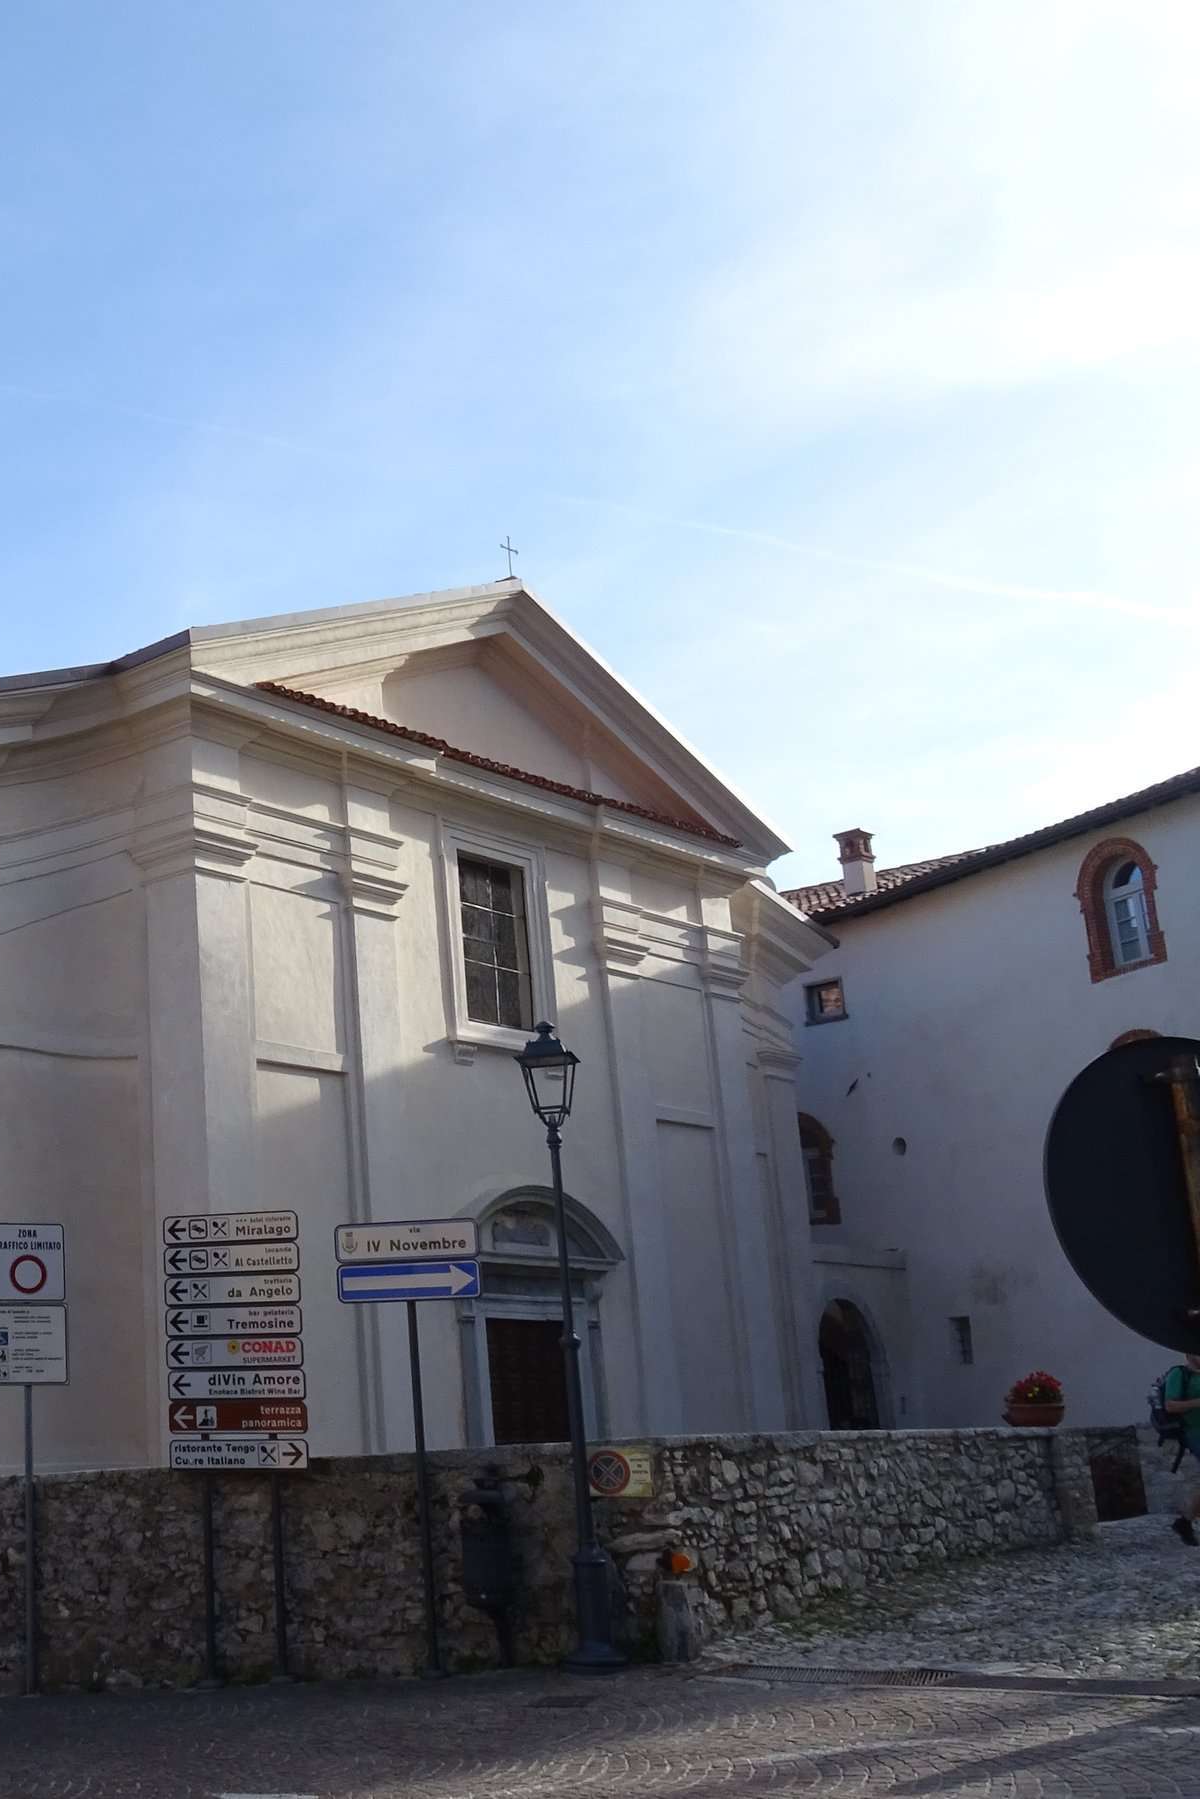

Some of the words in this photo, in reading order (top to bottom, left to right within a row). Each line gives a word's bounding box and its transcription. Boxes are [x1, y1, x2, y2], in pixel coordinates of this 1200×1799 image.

[18, 1229, 37, 1238] ZONA
[235, 1224, 291, 1237] Miralago
[30, 1241, 61, 1250] LIMITATO
[366, 1240, 381, 1252] IV
[390, 1238, 466, 1251] Novembre
[235, 1258, 244, 1267] Al
[246, 1255, 293, 1267] Castelletto
[227, 1287, 242, 1298] da
[249, 1286, 293, 1298] Angelo
[263, 1309, 294, 1317] gelateria
[227, 1319, 294, 1330] Tremosine
[241, 1340, 296, 1353] CONAD
[242, 1356, 296, 1364] SUPERMARKET
[208, 1374, 246, 1386] diVin
[252, 1373, 301, 1386] Amore
[260, 1406, 302, 1415] terrazza
[241, 1418, 302, 1429] panoramica
[174, 1443, 222, 1453] ristorante
[225, 1443, 256, 1454] Tengo
[174, 1456, 204, 1466] Cure
[207, 1456, 246, 1465] Italiano
